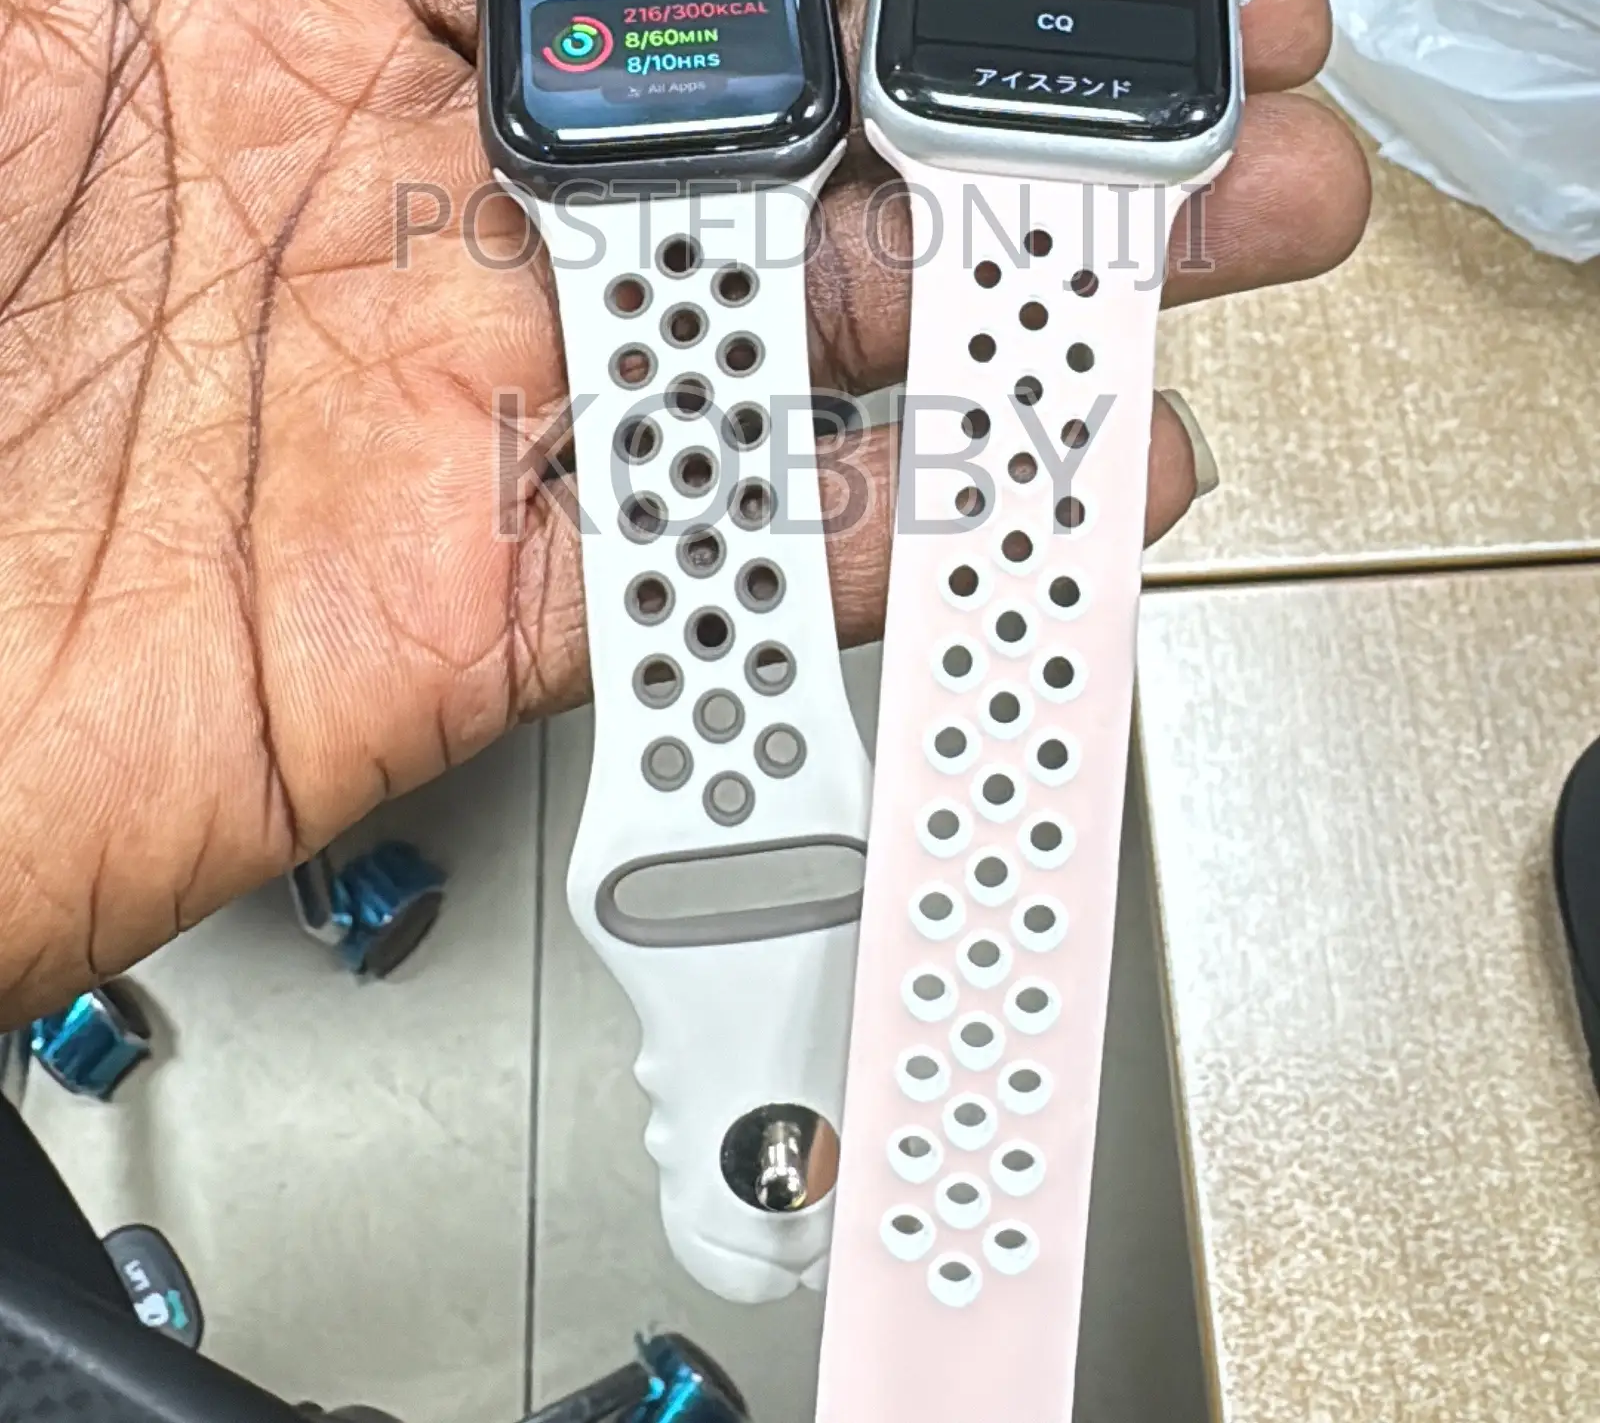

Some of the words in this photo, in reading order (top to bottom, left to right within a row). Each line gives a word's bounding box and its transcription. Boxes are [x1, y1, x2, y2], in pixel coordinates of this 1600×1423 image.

[623, 0, 769, 24] 216/300KCAL
[1036, 13, 1074, 33] CQ
[625, 28, 719, 51] 8/60MIN
[626, 53, 721, 76] 8/10HRS
[974, 67, 1132, 99] アイスランド
